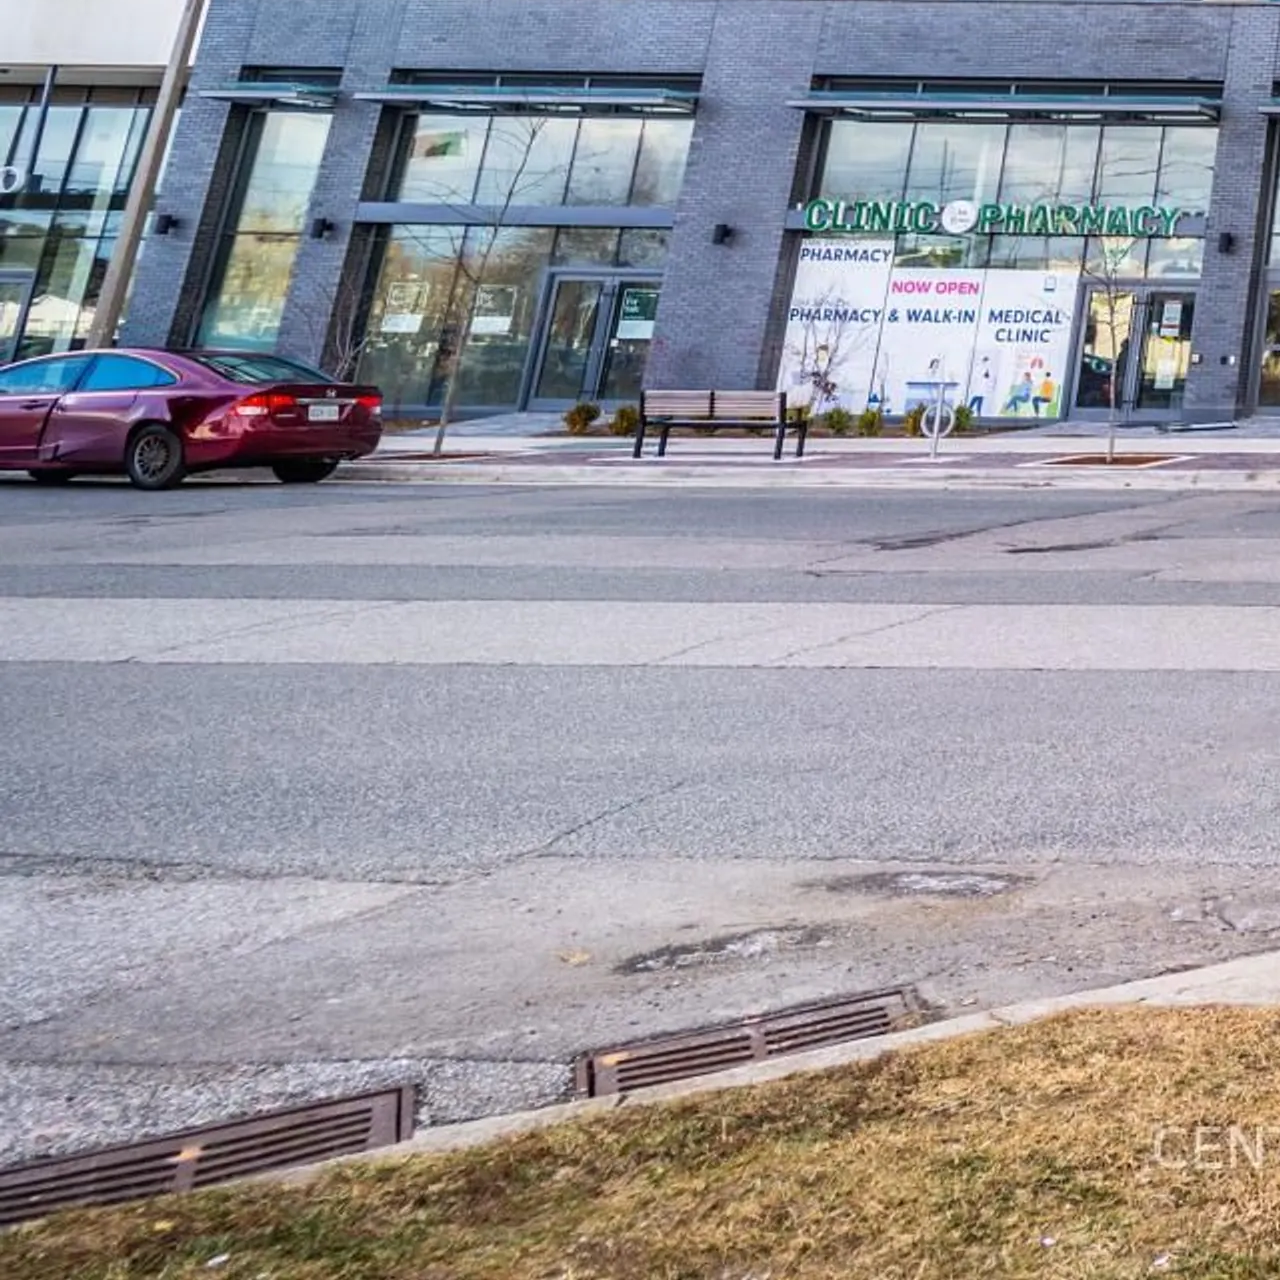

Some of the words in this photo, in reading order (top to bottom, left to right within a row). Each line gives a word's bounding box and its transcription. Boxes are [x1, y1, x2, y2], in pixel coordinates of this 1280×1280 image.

[805, 199, 938, 232] CLINIC
[979, 204, 1181, 236] PHARMACY
[800, 247, 892, 263] PHARMACY
[892, 281, 932, 294] NOW
[935, 282, 979, 295] OPEN
[789, 307, 882, 324] PHARMACY
[888, 308, 900, 323] &
[906, 308, 975, 324] WALK-IN
[988, 310, 1062, 325] MEDICAL
[995, 329, 1051, 343] CLINIC
